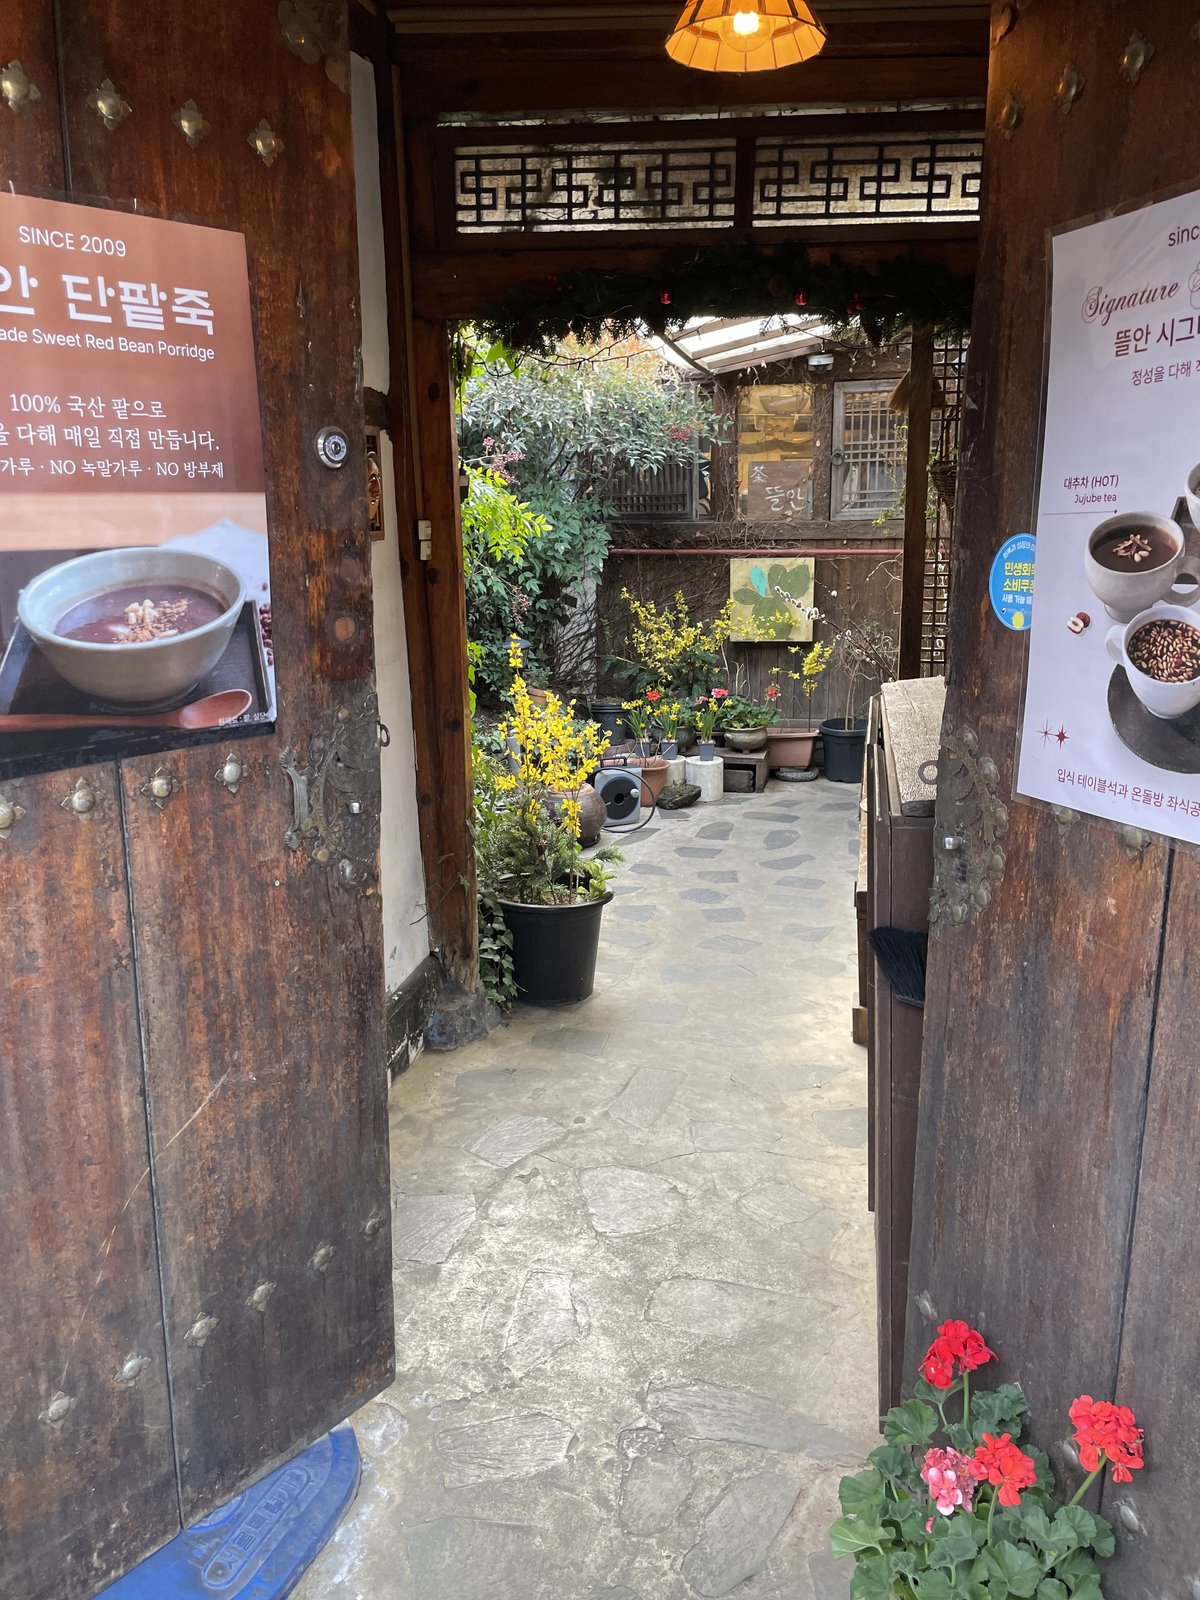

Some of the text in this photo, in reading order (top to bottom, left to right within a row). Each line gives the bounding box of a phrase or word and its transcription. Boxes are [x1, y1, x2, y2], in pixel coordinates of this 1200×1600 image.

[19, 226, 126, 257] SINCE 2009
[61, 273, 215, 335] 단팥죽
[1082, 279, 1181, 326] Signature
[33, 328, 82, 348] Sweet
[85, 334, 115, 350] Red
[119, 337, 154, 354] Bean
[158, 341, 215, 362] Porridge
[1114, 317, 1200, 357] 뜰안 시그
[1131, 366, 1165, 386] 정성을
[1168, 360, 1192, 379] 다해
[9, 393, 167, 420] 100% 국산 팥으로
[16, 423, 56, 447] 다해
[63, 426, 102, 448] 매일
[108, 428, 140, 450] 직접
[147, 429, 220, 451] 만듭니다.
[50, 459, 76, 475] NO
[81, 459, 143, 479] 녹말가루
[156, 462, 179, 477] NO
[183, 461, 224, 479] 방부제
[1064, 474, 1119, 490] 대추차 (HOT)
[765, 485, 806, 511] 뜰안
[1074, 493, 1117, 505] Jujube tea
[1057, 768, 1075, 785] 입식
[1077, 774, 1129, 799] 테이블석과
[1131, 786, 1165, 808] 온돌방
